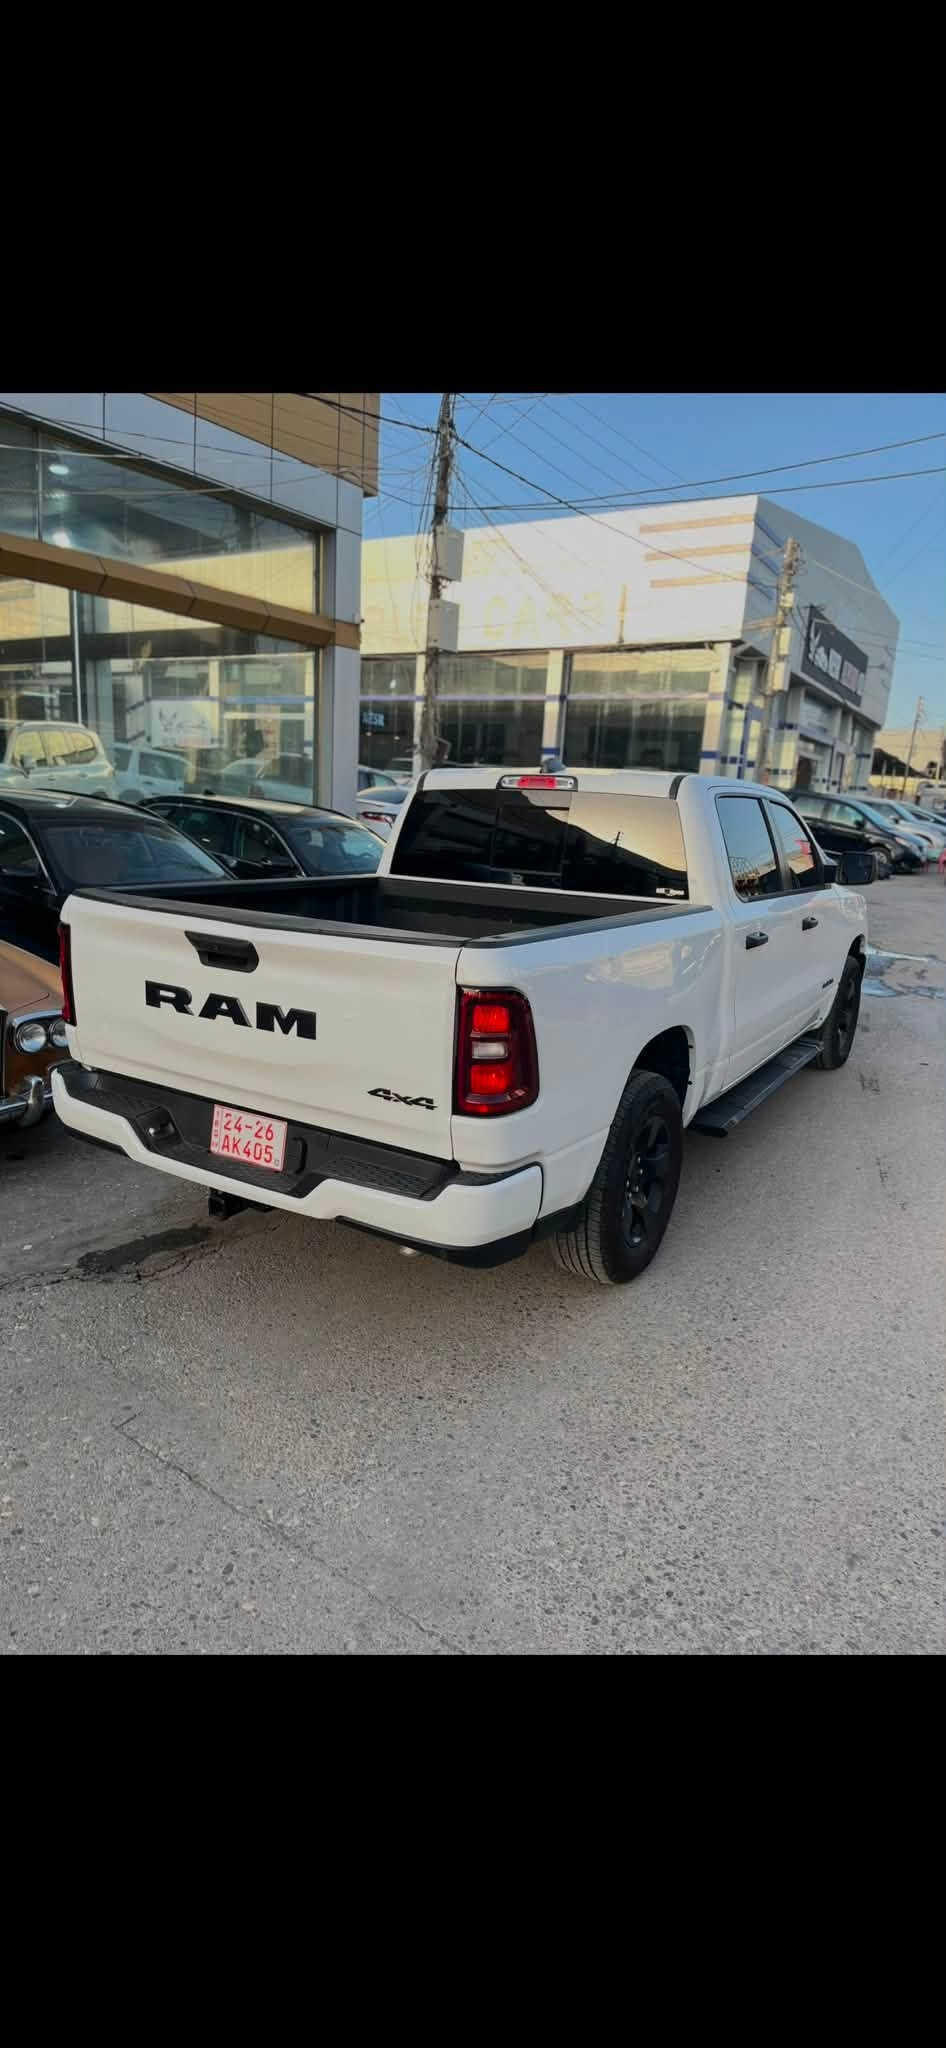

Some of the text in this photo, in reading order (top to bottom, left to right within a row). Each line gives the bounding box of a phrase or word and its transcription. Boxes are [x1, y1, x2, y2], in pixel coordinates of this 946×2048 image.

[145, 980, 317, 1040] RAM
[223, 1112, 274, 1141] 24-26
[221, 1134, 274, 1163] AK405
